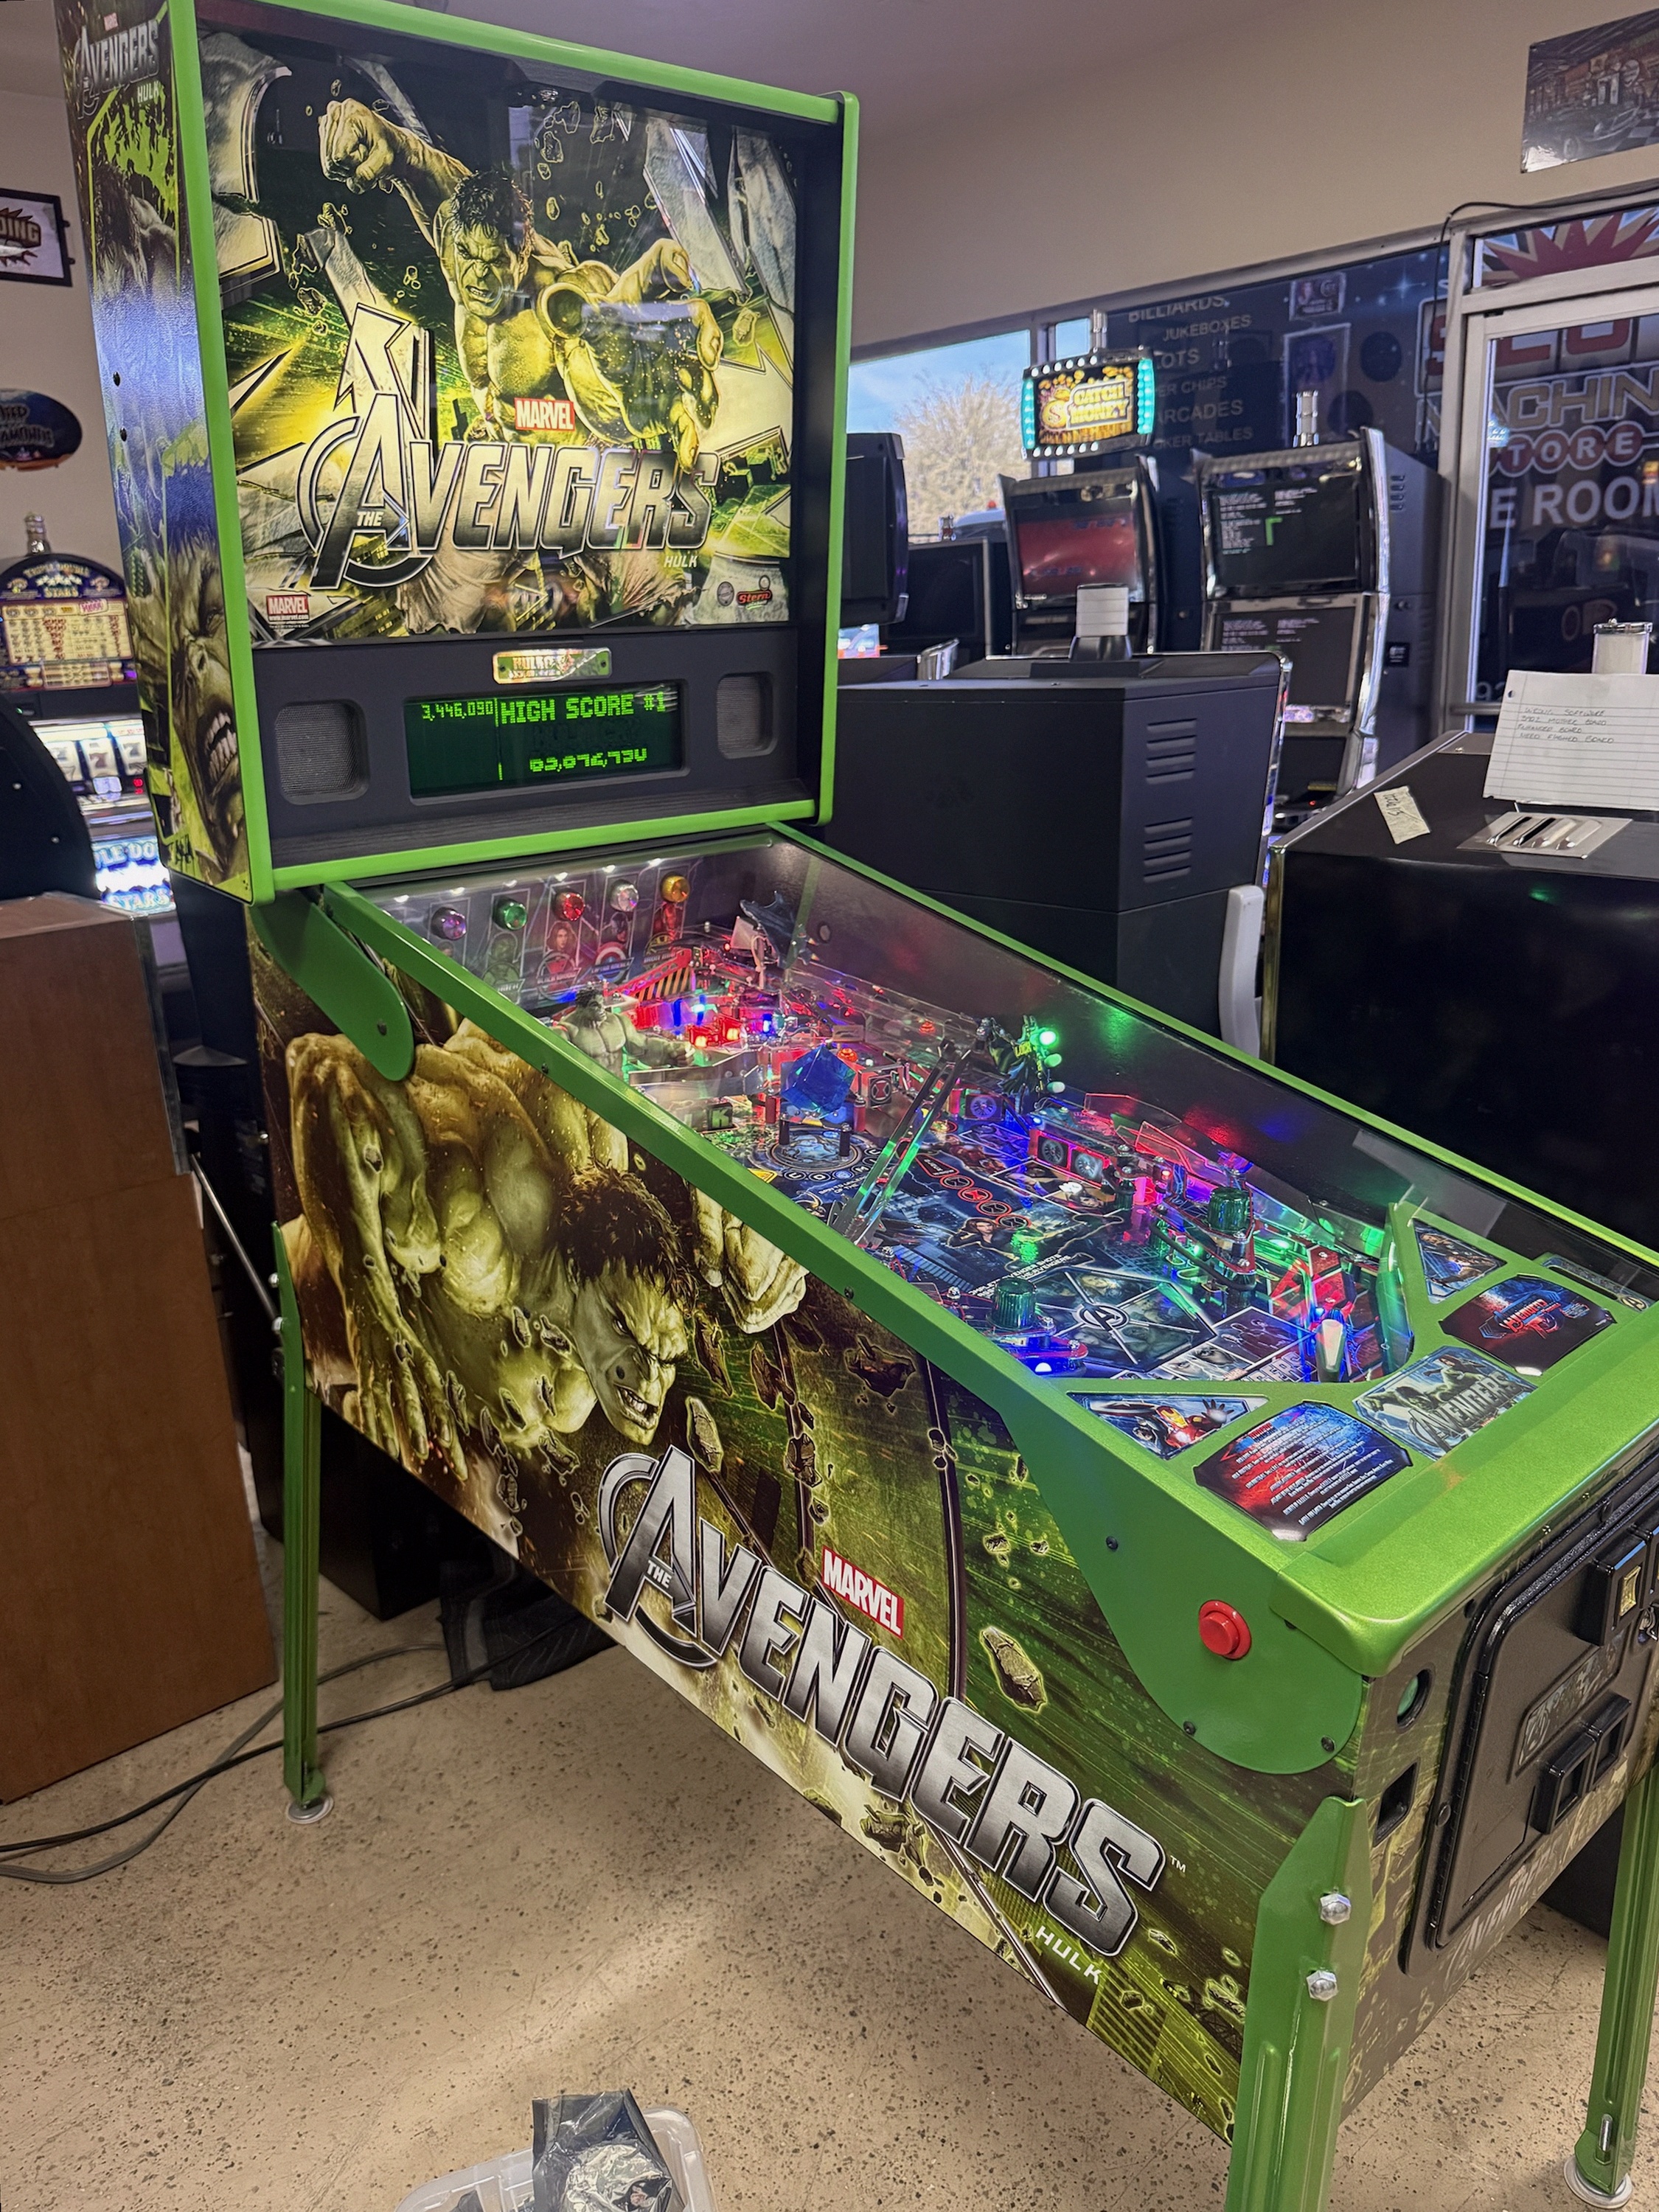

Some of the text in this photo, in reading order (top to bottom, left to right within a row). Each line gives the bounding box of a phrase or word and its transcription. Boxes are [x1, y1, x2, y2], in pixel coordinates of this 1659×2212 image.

[74, 18, 159, 119] AVENGERS
[137, 80, 160, 104] HULK
[1163, 314, 1252, 342] JUKEBOXES
[1160, 348, 1200, 369] OTS
[1180, 376, 1228, 394] CHIPS
[516, 400, 574, 429] MARVEL
[1153, 426, 1253, 449] OKER TABLES
[1506, 429, 1635, 465] TORE
[296, 393, 720, 590] AVENGERS
[356, 509, 383, 528] THE
[663, 554, 698, 568] HULK
[44, 586, 80, 599] STARS
[268, 596, 309, 615] MARVEL
[738, 593, 769, 604] Stern
[421, 691, 667, 724] 3,446,090 HIGH SCORE #1
[128, 841, 158, 860] DO
[108, 888, 170, 910] STARS
[1408, 1370, 1523, 1453] AVENGERS
[646, 1560, 672, 1589] THE
[824, 1548, 902, 1636] MARVEL
[597, 1444, 1166, 1957] AVENGERS
[1035, 1925, 1104, 1986] HULK
